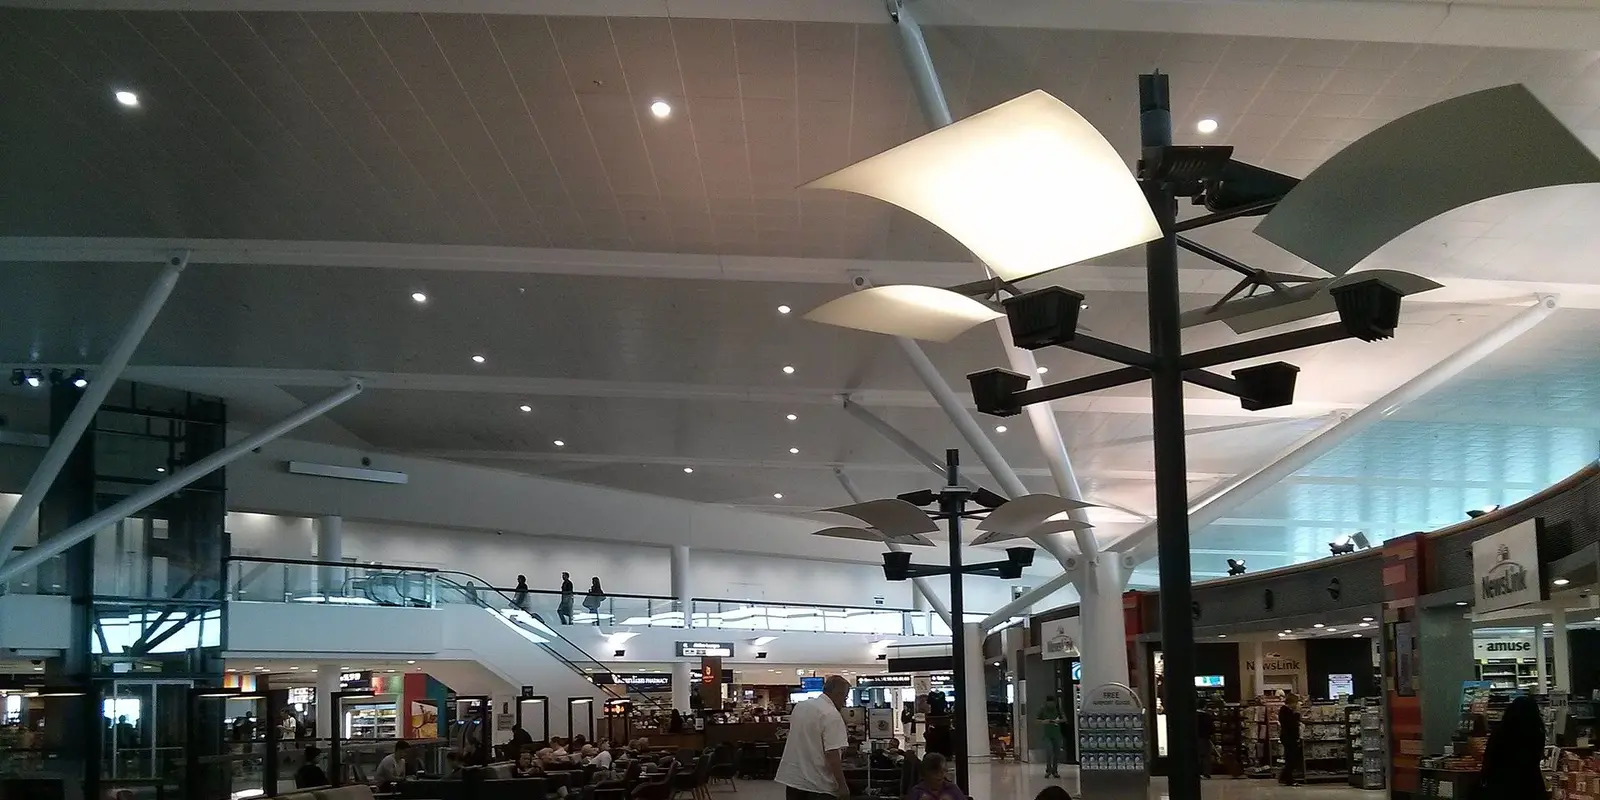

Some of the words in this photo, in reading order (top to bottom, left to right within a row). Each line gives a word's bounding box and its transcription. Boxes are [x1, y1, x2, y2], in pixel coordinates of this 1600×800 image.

[1482, 565, 1527, 599] NewsLink
[1487, 641, 1531, 652] amuse
[1246, 659, 1300, 671] NwsLink
[1103, 691, 1120, 699] FREE
